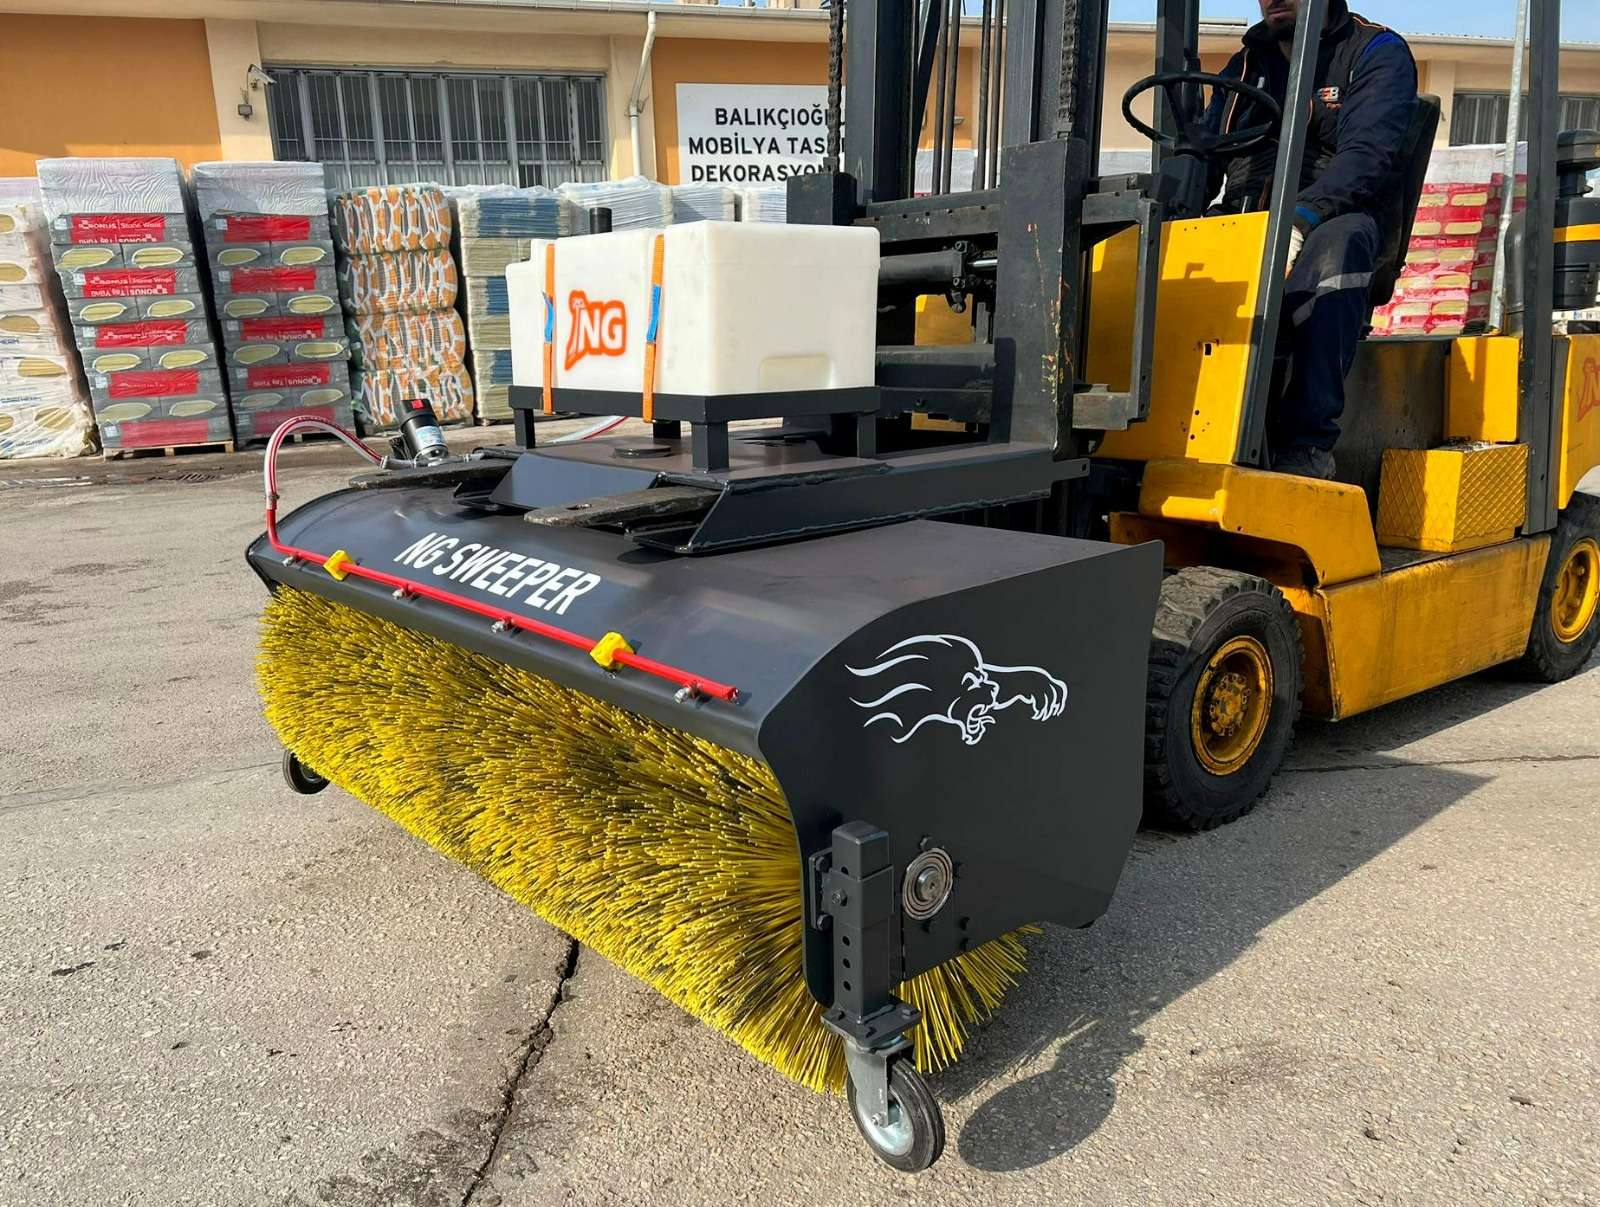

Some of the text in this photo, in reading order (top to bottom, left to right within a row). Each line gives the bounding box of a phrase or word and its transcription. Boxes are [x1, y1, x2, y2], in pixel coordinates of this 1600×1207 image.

[715, 104, 846, 130] BALIKÇIOĞ
[688, 132, 781, 154] MOBİLYA
[691, 164, 828, 182] DEKORASYO
[130, 288, 157, 296] BONUS
[394, 532, 601, 616] NG SWEEPER
